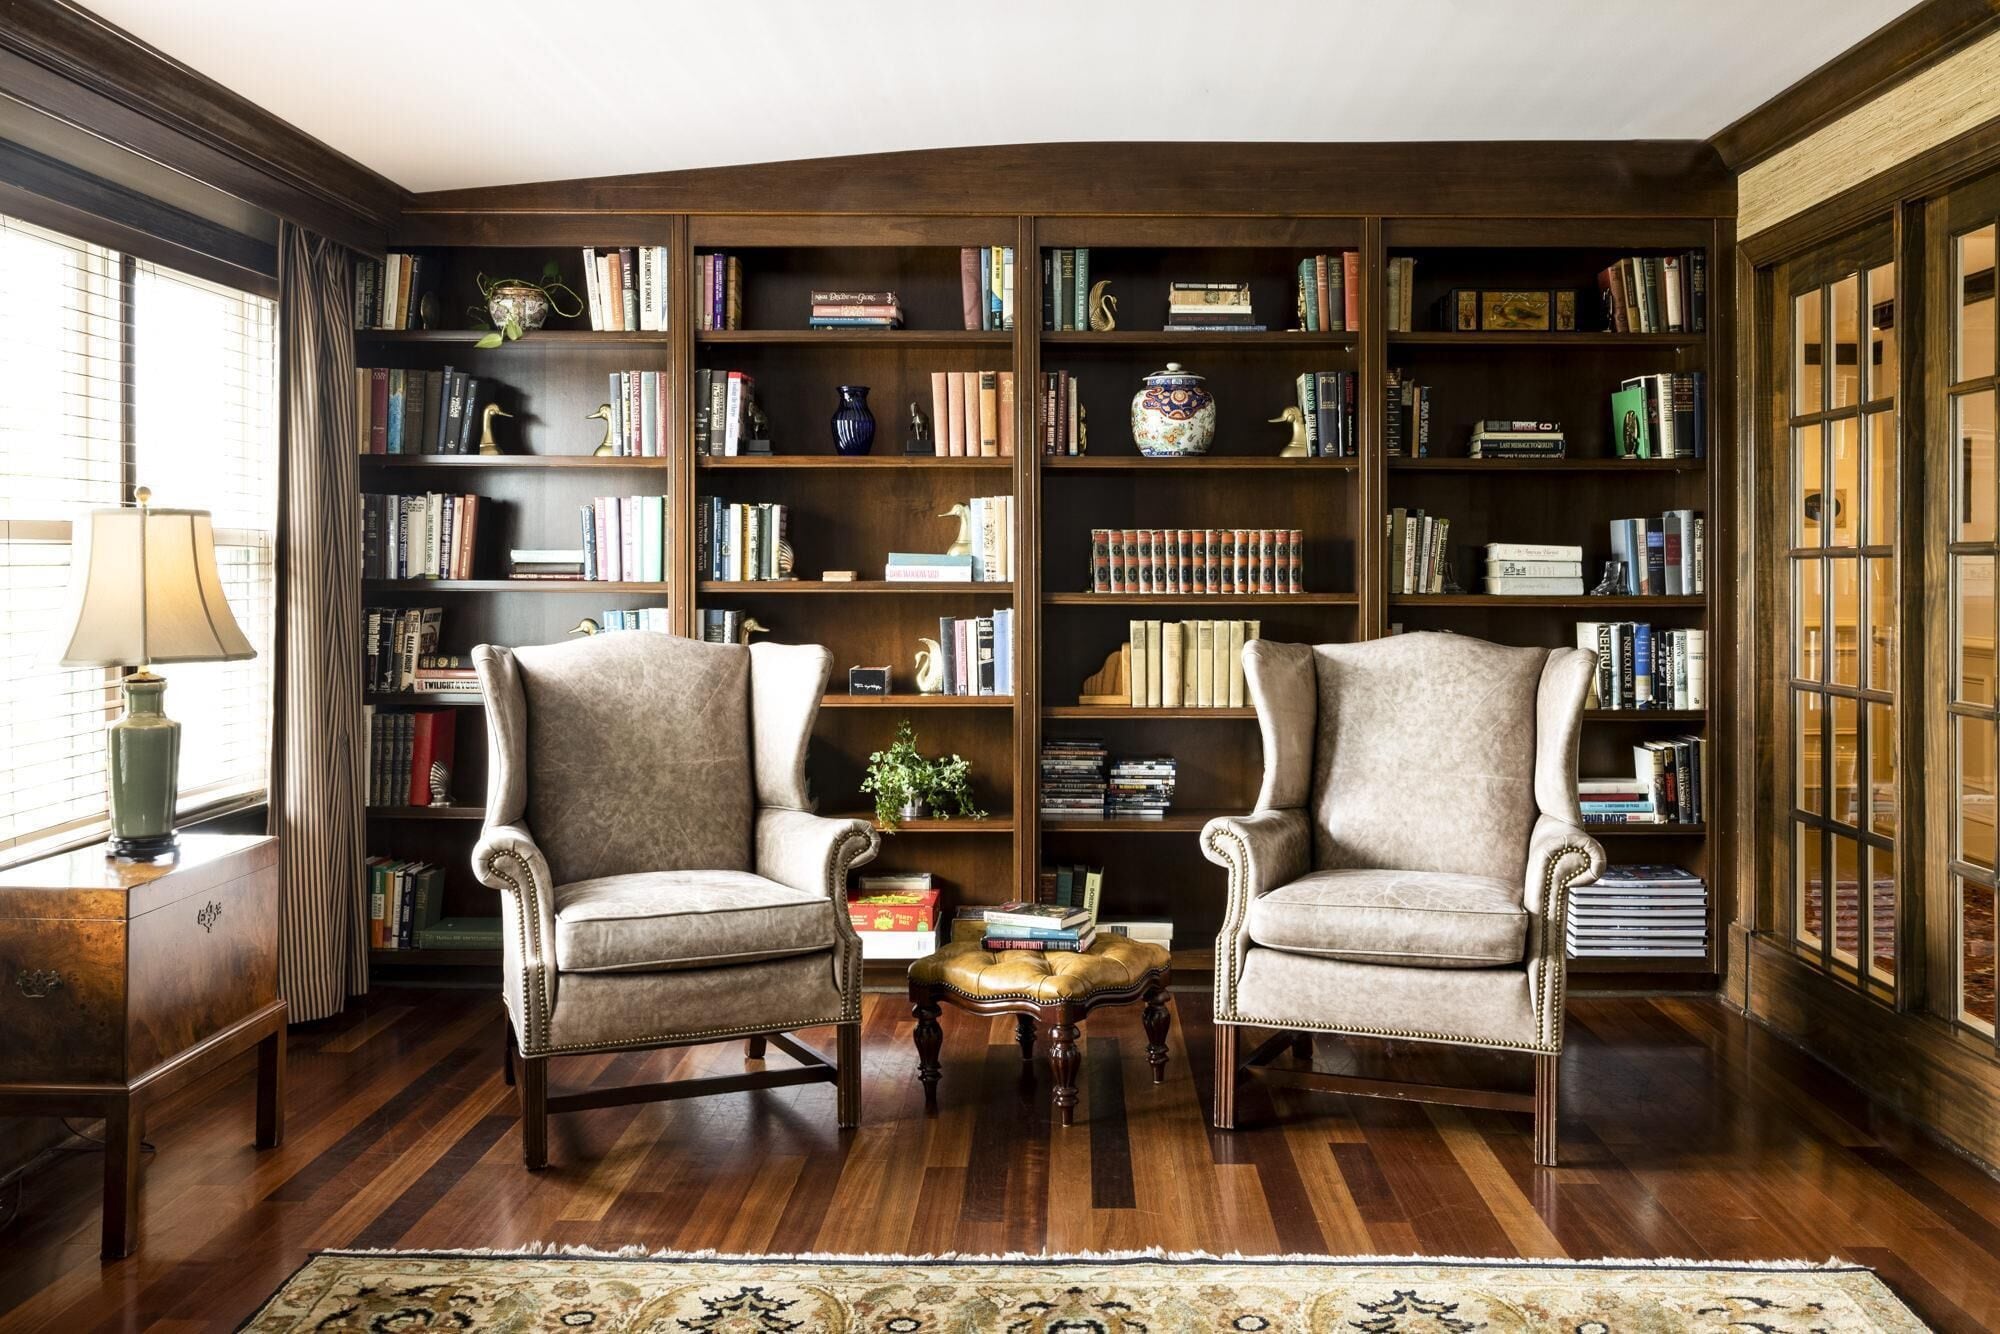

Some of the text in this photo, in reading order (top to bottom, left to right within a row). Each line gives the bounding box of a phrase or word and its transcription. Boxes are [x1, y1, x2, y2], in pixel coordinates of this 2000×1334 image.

[624, 263, 632, 288] MARIE
[1308, 414, 1316, 428] PETER
[699, 544, 703, 554] OF
[367, 614, 380, 655] White Knight
[1600, 627, 1611, 669] NEHRU
[404, 654, 413, 674] DRURY
[1605, 814, 1627, 822] DAYS
[988, 940, 1004, 949] TARGET
[1005, 941, 1012, 949] OF
[1013, 941, 1043, 949] OPPORTUNITY
